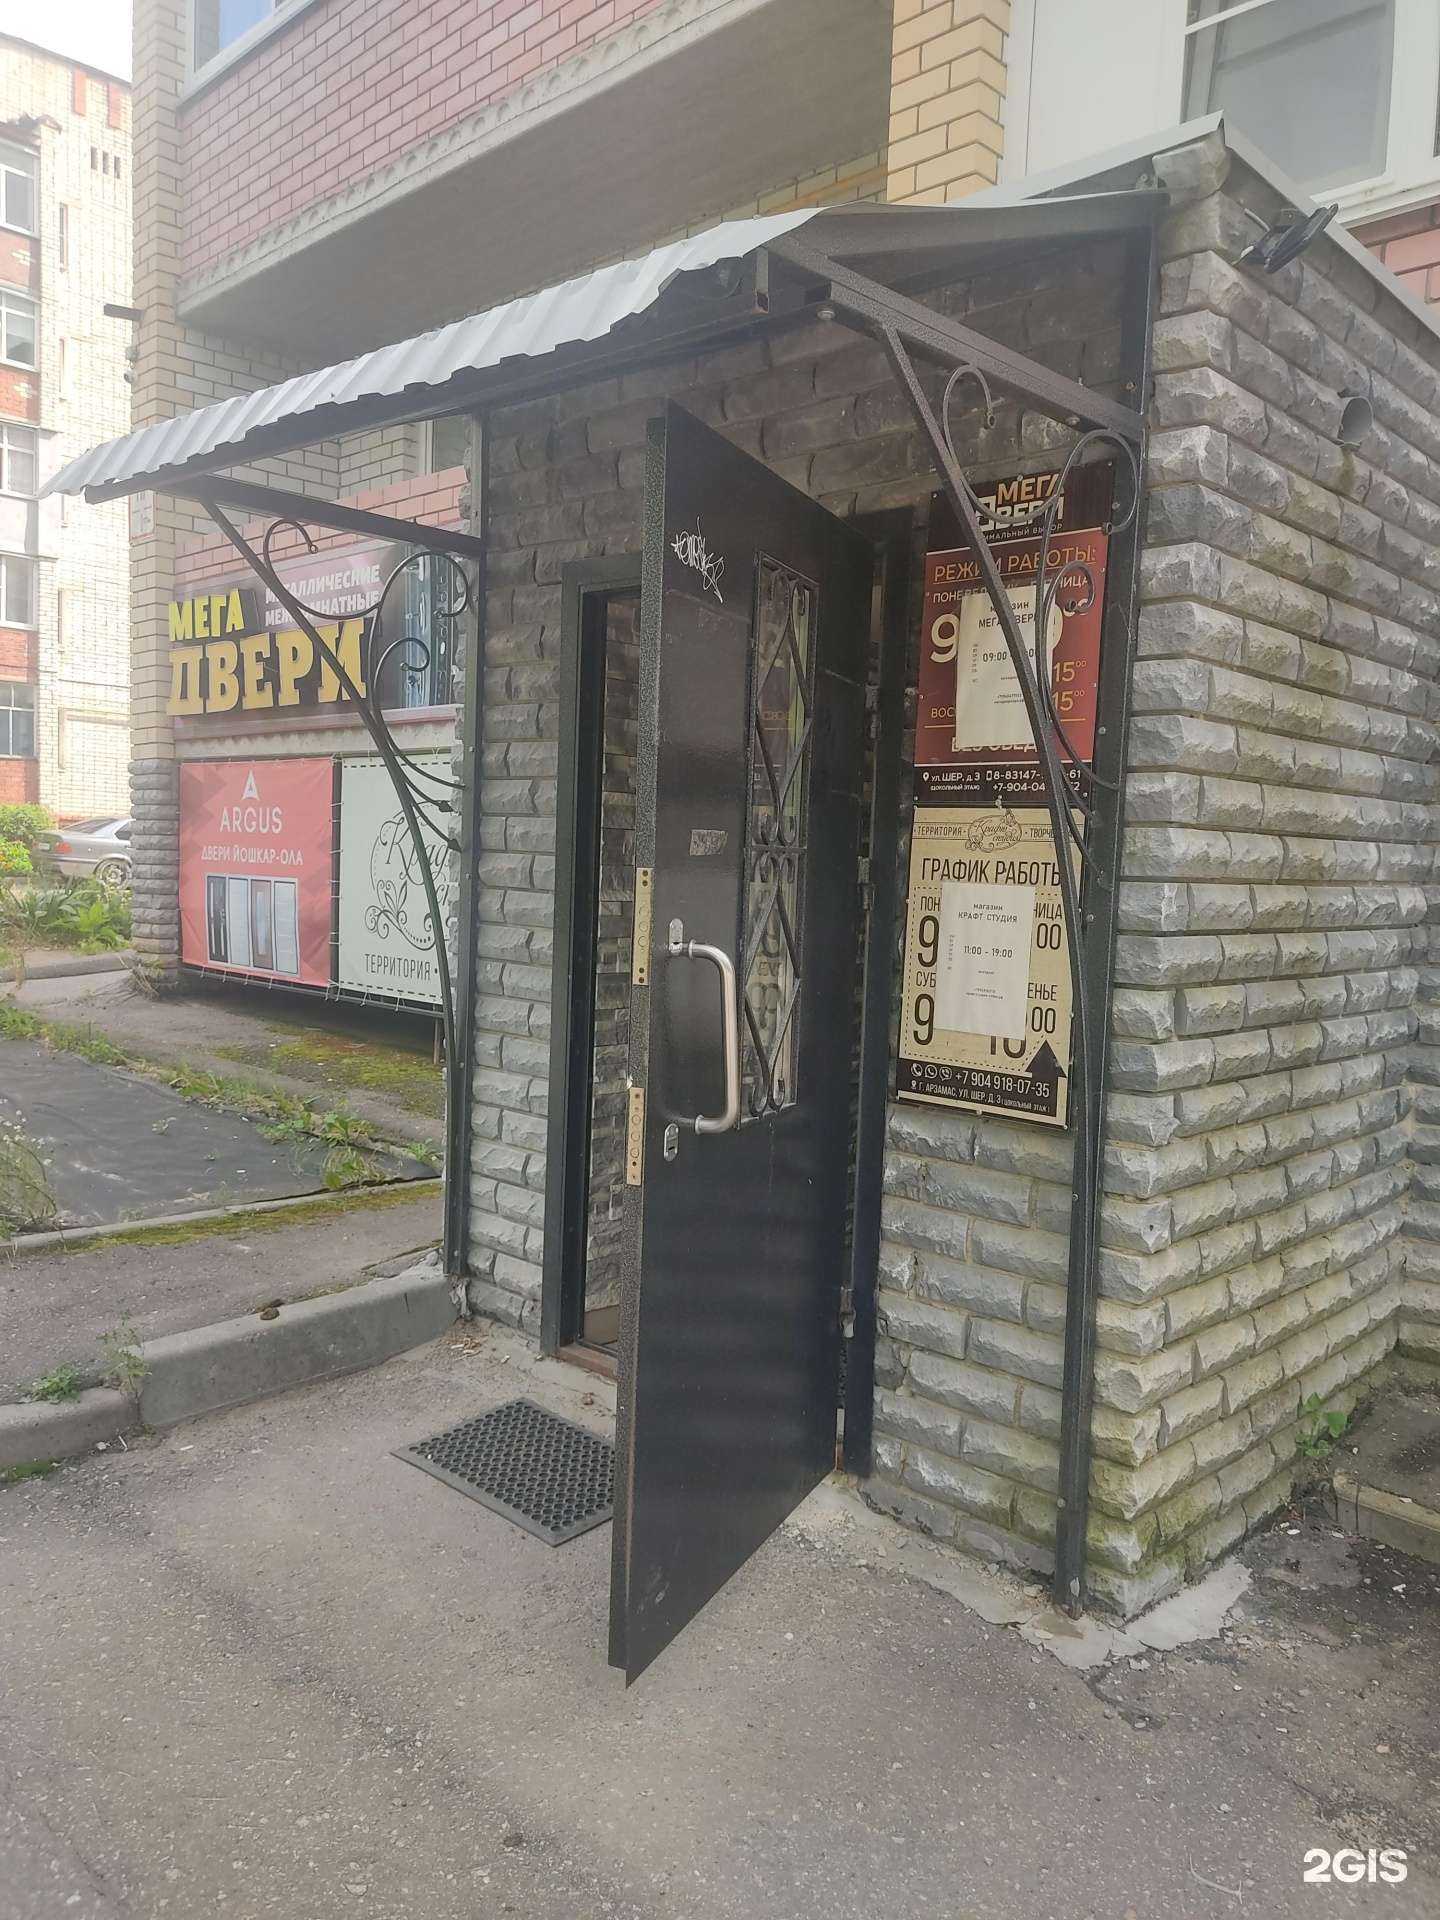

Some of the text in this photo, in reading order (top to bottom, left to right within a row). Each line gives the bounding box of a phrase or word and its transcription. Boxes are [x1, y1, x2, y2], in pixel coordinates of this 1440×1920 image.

[168, 588, 245, 641] МЕГА
[167, 617, 367, 716] ДВЕРИ
[219, 806, 283, 834] ARGUS
[201, 845, 304, 866] ДВЕРИ ЙОШКАР-ОЛА
[921, 857, 991, 883] ГРАФИК
[958, 911, 1018, 923] КРАФТ СТУДИЯ
[917, 914, 940, 968] 9
[963, 945, 982, 956] 11:00
[991, 947, 1013, 959] 19:00
[364, 953, 431, 980] ТЕРРИТОРИЯ
[913, 993, 935, 1046] 9
[955, 1070, 1051, 1099] +7 904 918-07-35
